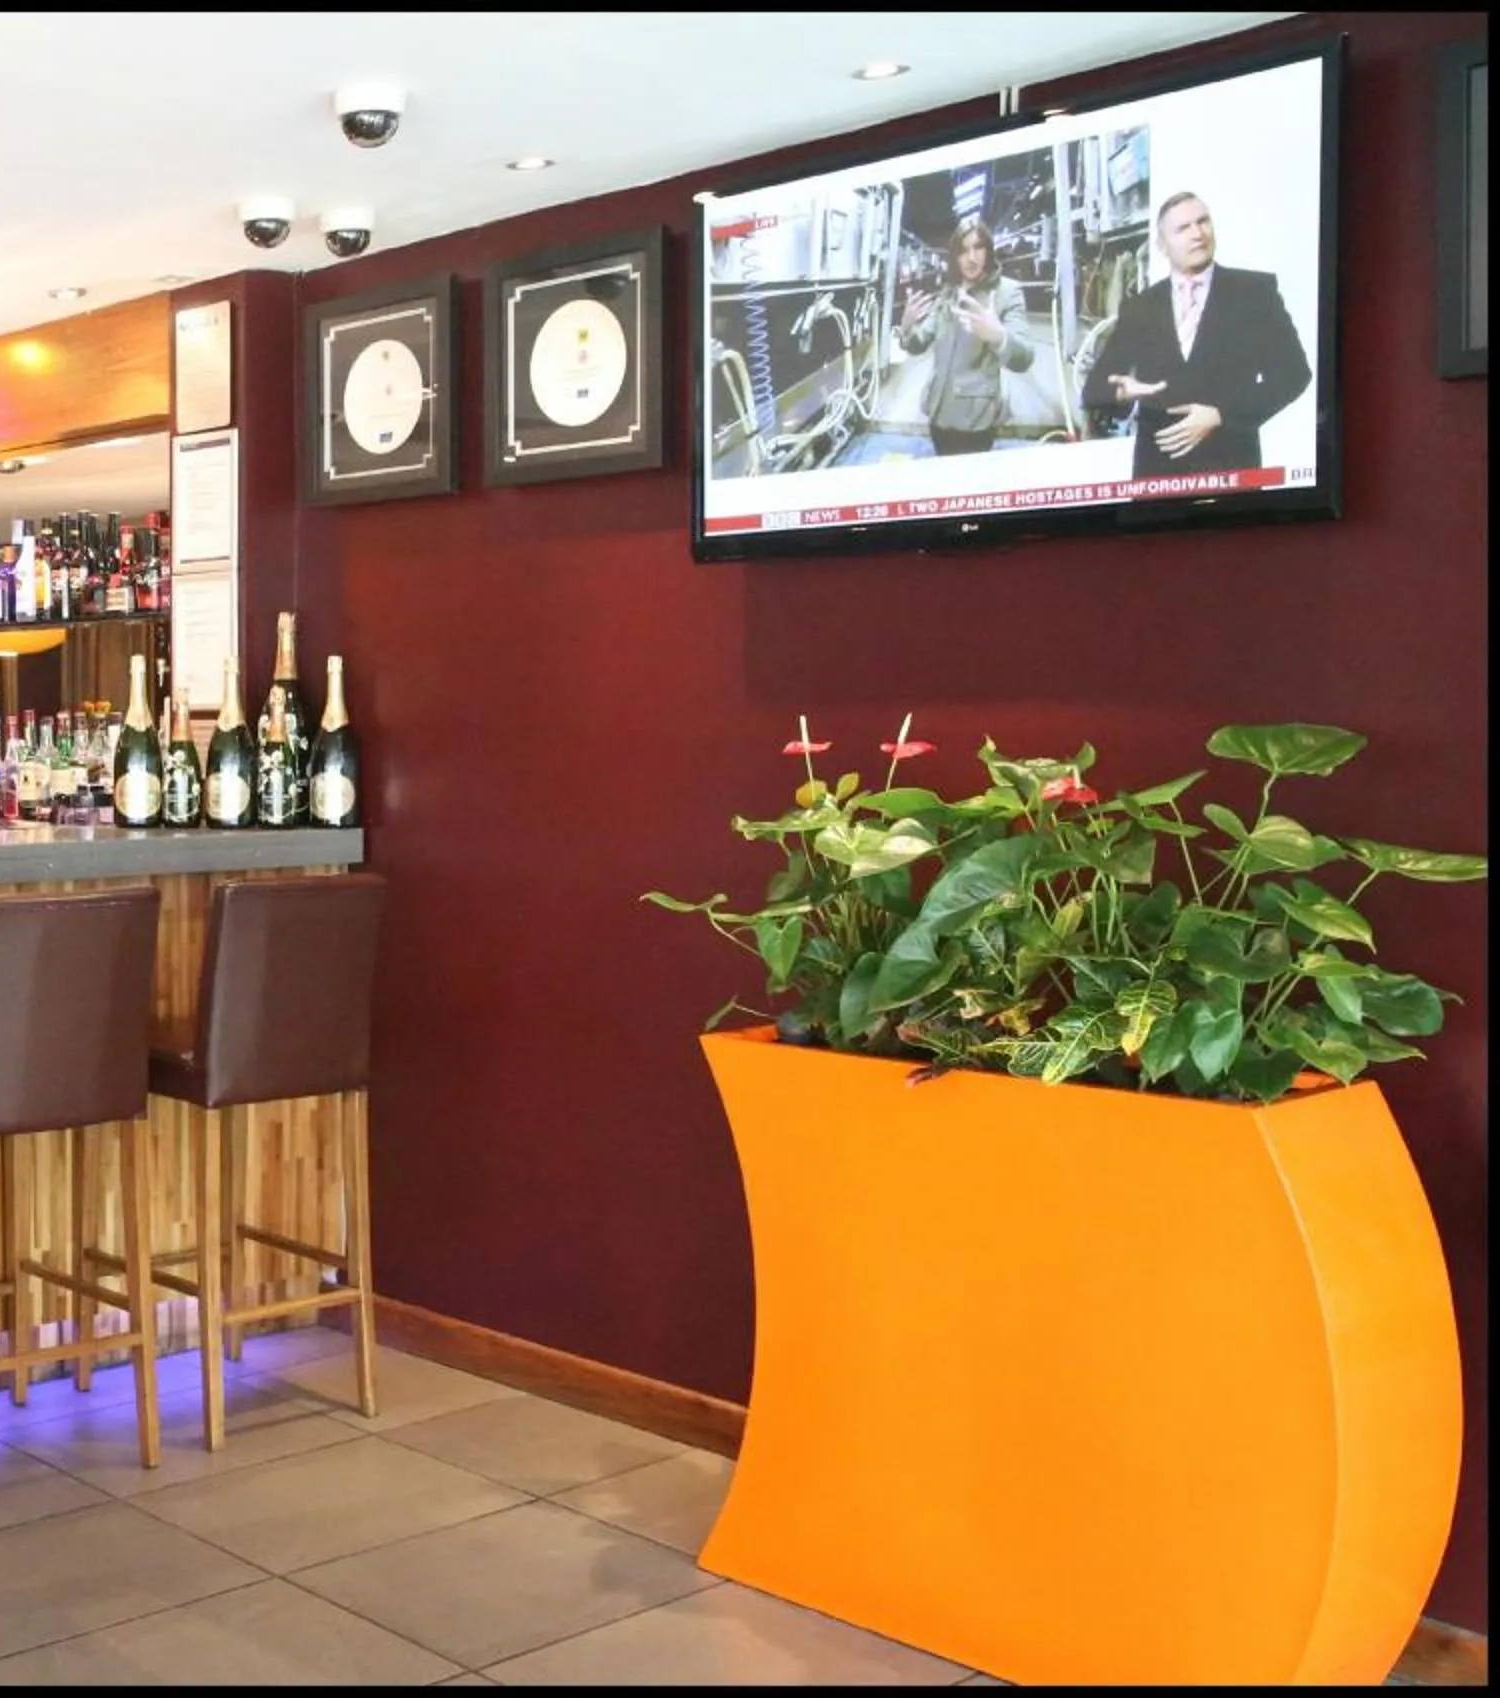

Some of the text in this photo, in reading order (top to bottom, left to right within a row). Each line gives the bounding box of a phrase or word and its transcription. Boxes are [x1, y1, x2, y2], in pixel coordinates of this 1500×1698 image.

[909, 499, 939, 513] TWO
[941, 493, 1012, 511] JAPANESE
[1015, 485, 1093, 504] HOSTAGES
[1097, 485, 1112, 497] IS
[1117, 473, 1238, 496] UNFORGIVABLE
